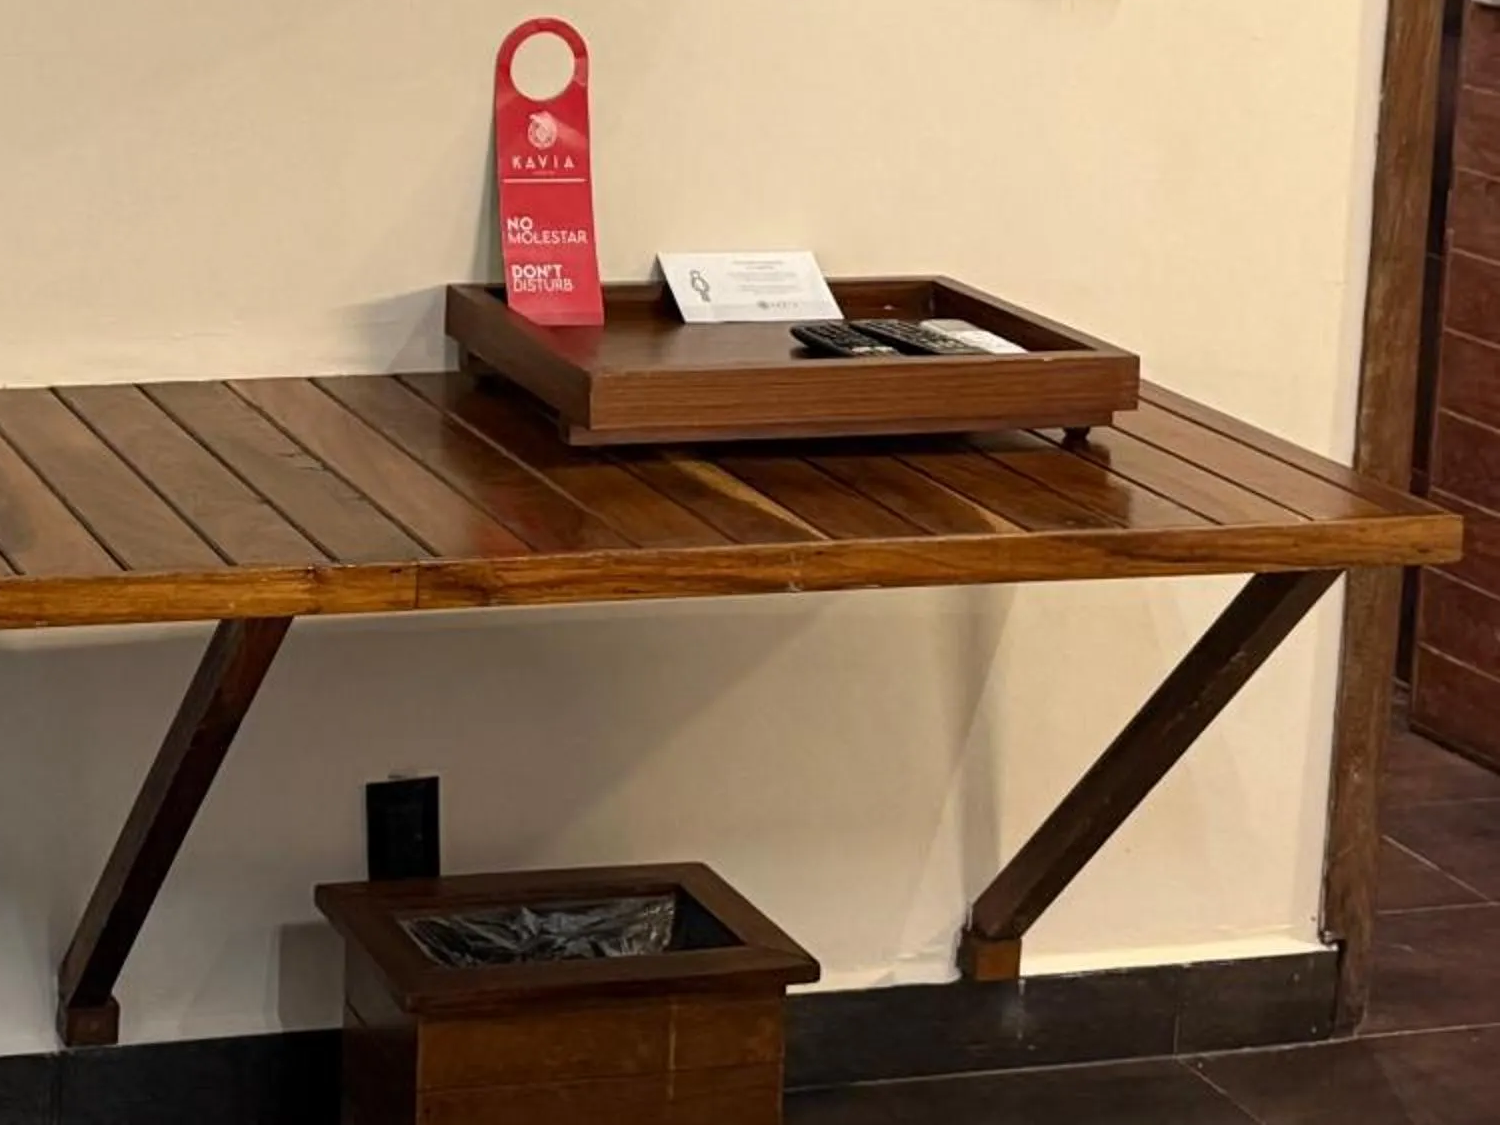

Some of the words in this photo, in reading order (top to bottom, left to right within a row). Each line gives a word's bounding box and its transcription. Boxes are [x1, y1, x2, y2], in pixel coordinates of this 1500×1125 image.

[512, 155, 575, 170] KAVIA
[507, 216, 533, 230] NO
[508, 230, 588, 244] MOLESTAR
[511, 264, 562, 278] DON'T
[513, 278, 573, 292] DISTURB
